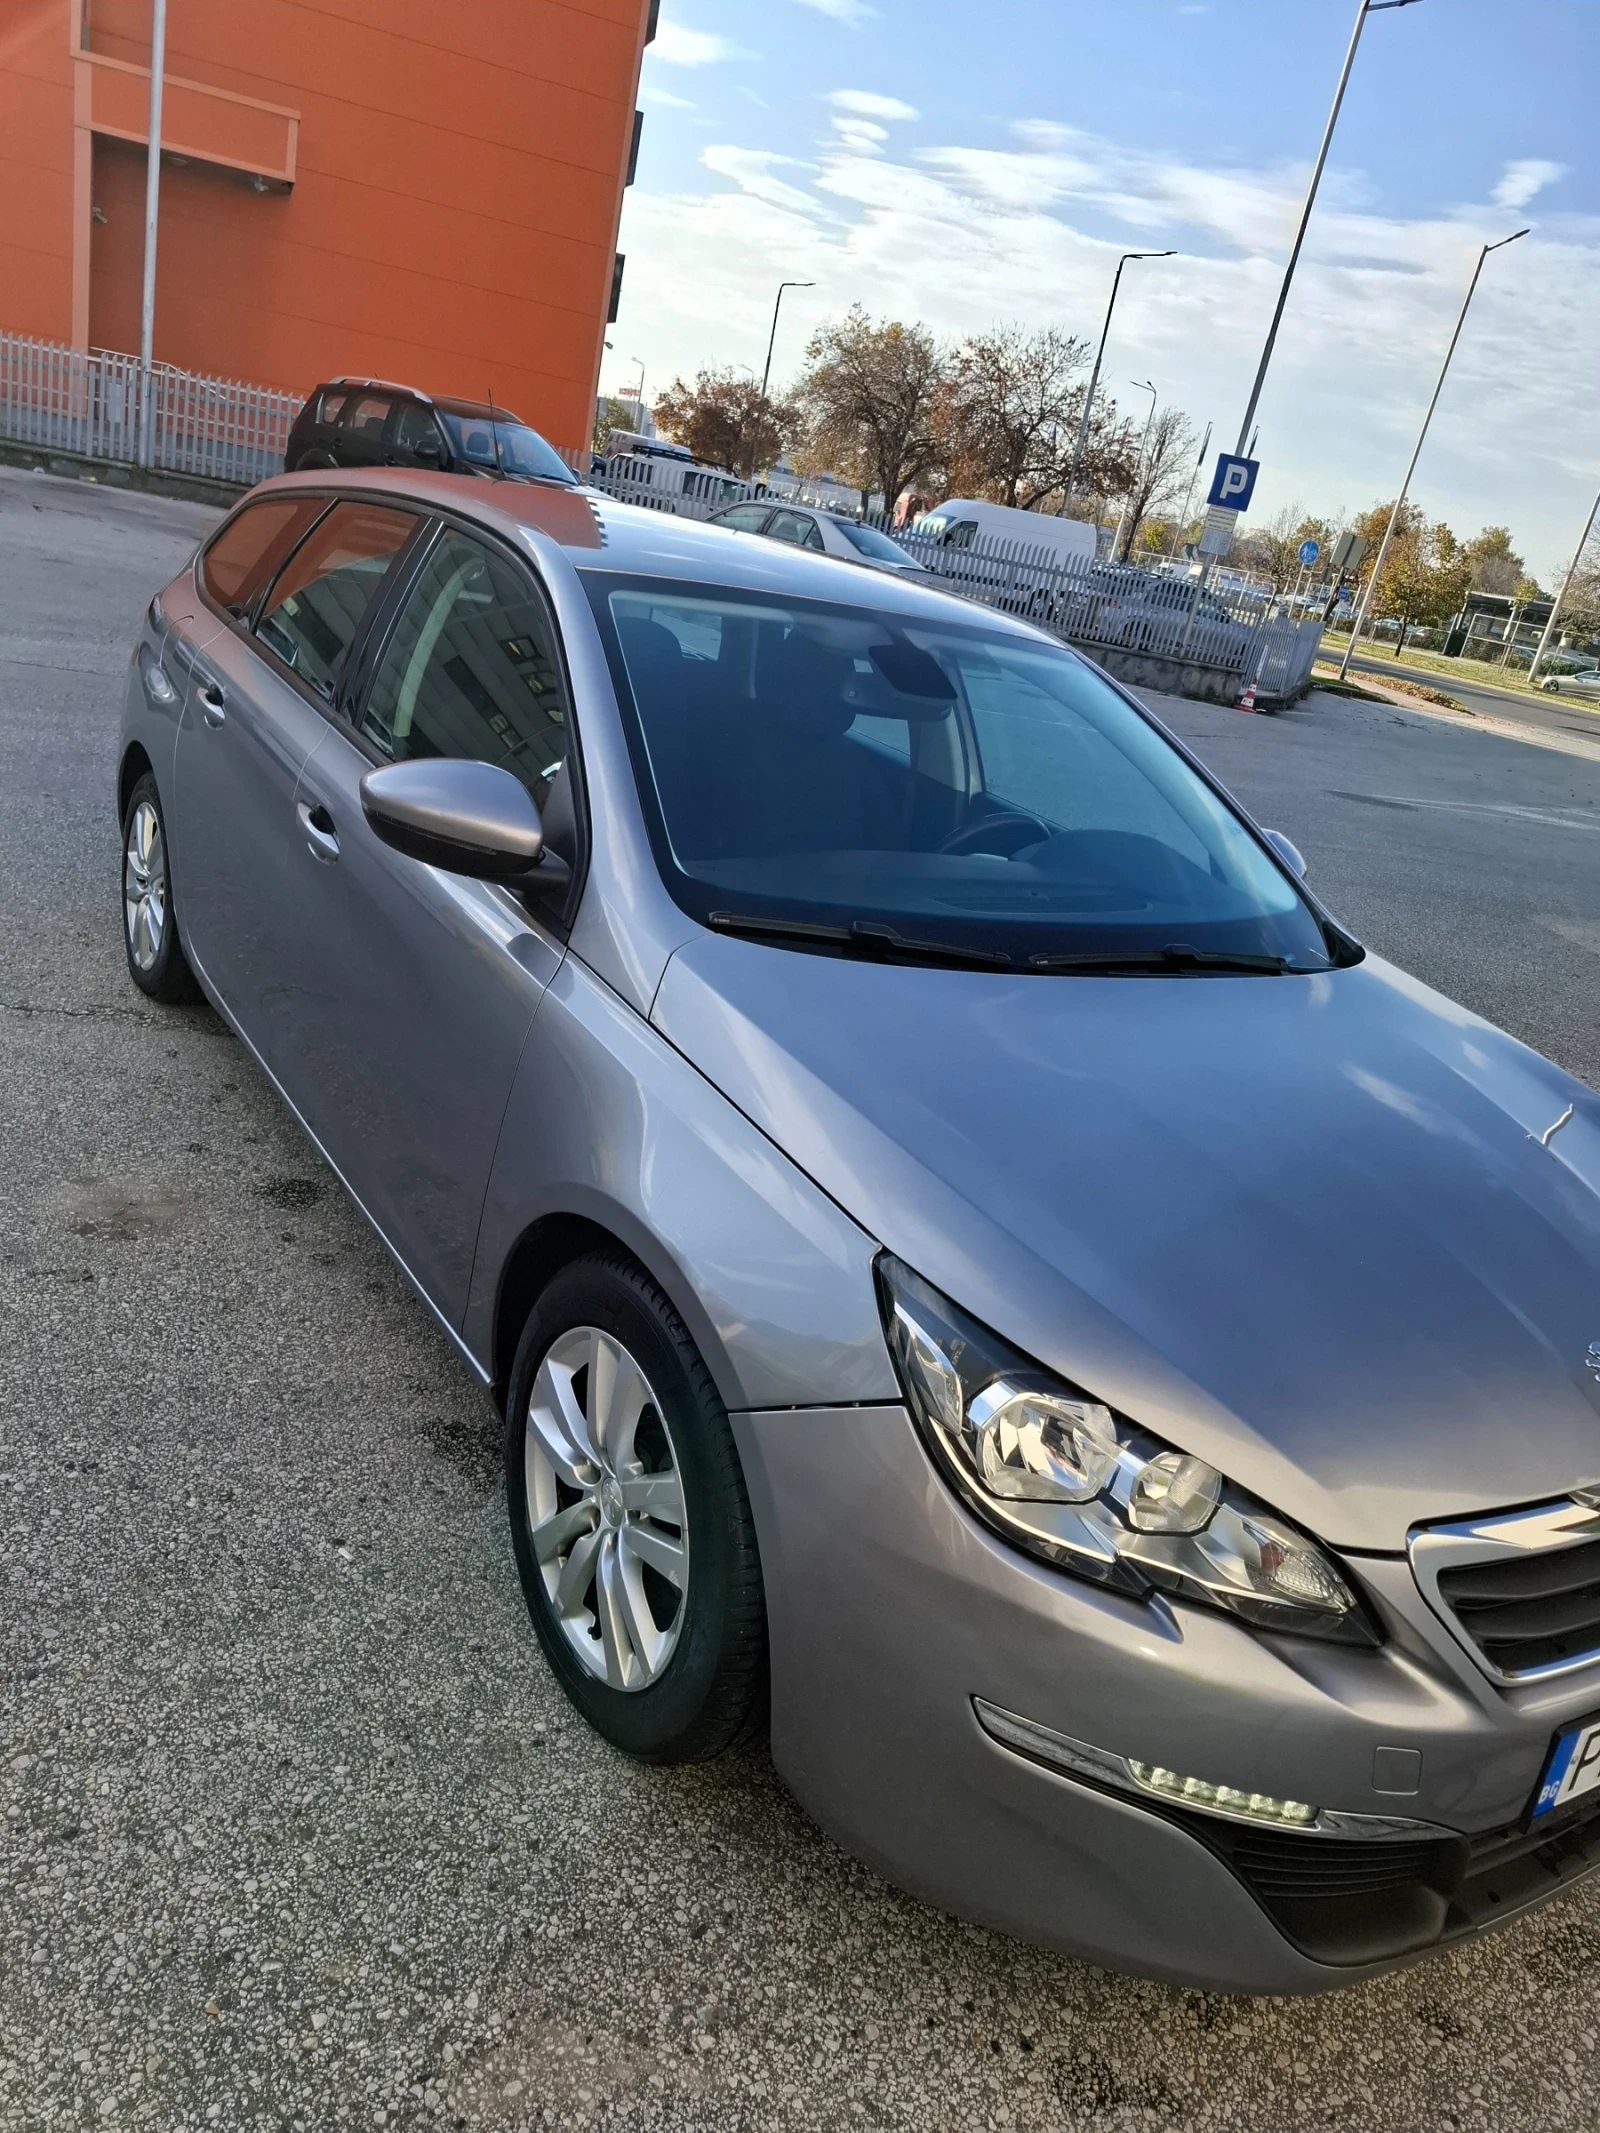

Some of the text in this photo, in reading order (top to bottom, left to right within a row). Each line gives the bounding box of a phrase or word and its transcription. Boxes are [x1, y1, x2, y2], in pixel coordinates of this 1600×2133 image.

[1219, 463, 1248, 499] P
[1567, 1729, 1600, 1792] P
[1538, 1780, 1560, 1804] BG
